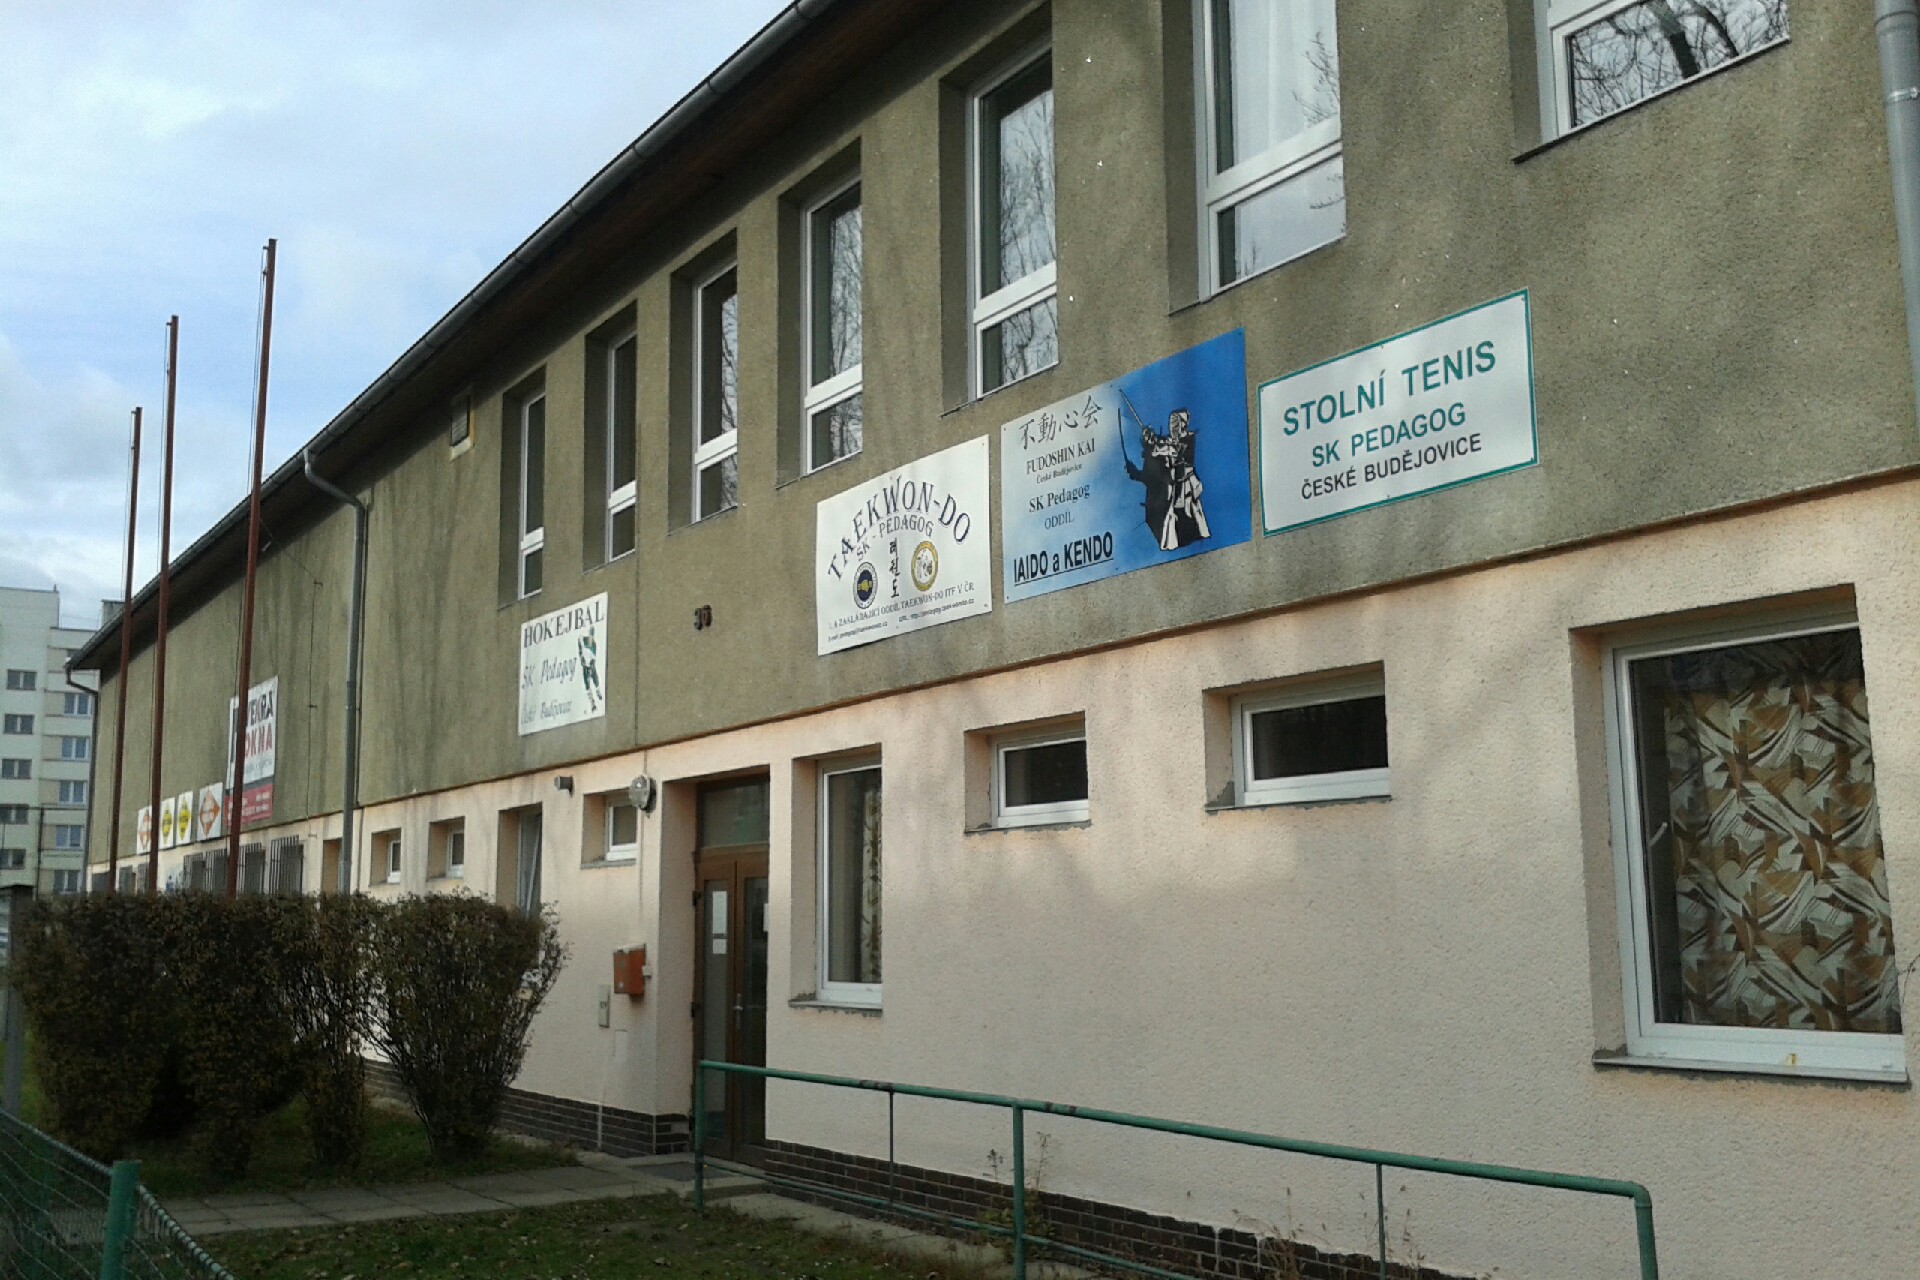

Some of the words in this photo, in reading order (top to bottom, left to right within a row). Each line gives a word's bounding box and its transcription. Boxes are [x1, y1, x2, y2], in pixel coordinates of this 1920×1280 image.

[1283, 369, 1386, 436] STOLNÍ
[1402, 340, 1496, 397] TENIS
[1018, 395, 1103, 450] 不動心会
[1312, 440, 1340, 468] SK
[1351, 402, 1466, 456] PEDAGOG
[1026, 447, 1075, 474] FUDOSHIN
[1078, 437, 1095, 457] KAI
[1302, 466, 1356, 500] ČESKÉ
[1365, 433, 1481, 483] BUDĚJOVICE
[1029, 493, 1044, 513] SK
[1047, 484, 1091, 508] Pedagog
[1044, 509, 1075, 530] ODDÍL
[827, 474, 971, 581] TAEKWON-DO
[879, 514, 934, 538] PEDAGOG
[1014, 550, 1048, 583] IAIDO
[1053, 553, 1060, 573] a
[1064, 531, 1113, 570] KENDO
[524, 600, 604, 648] HOKEJBAL
